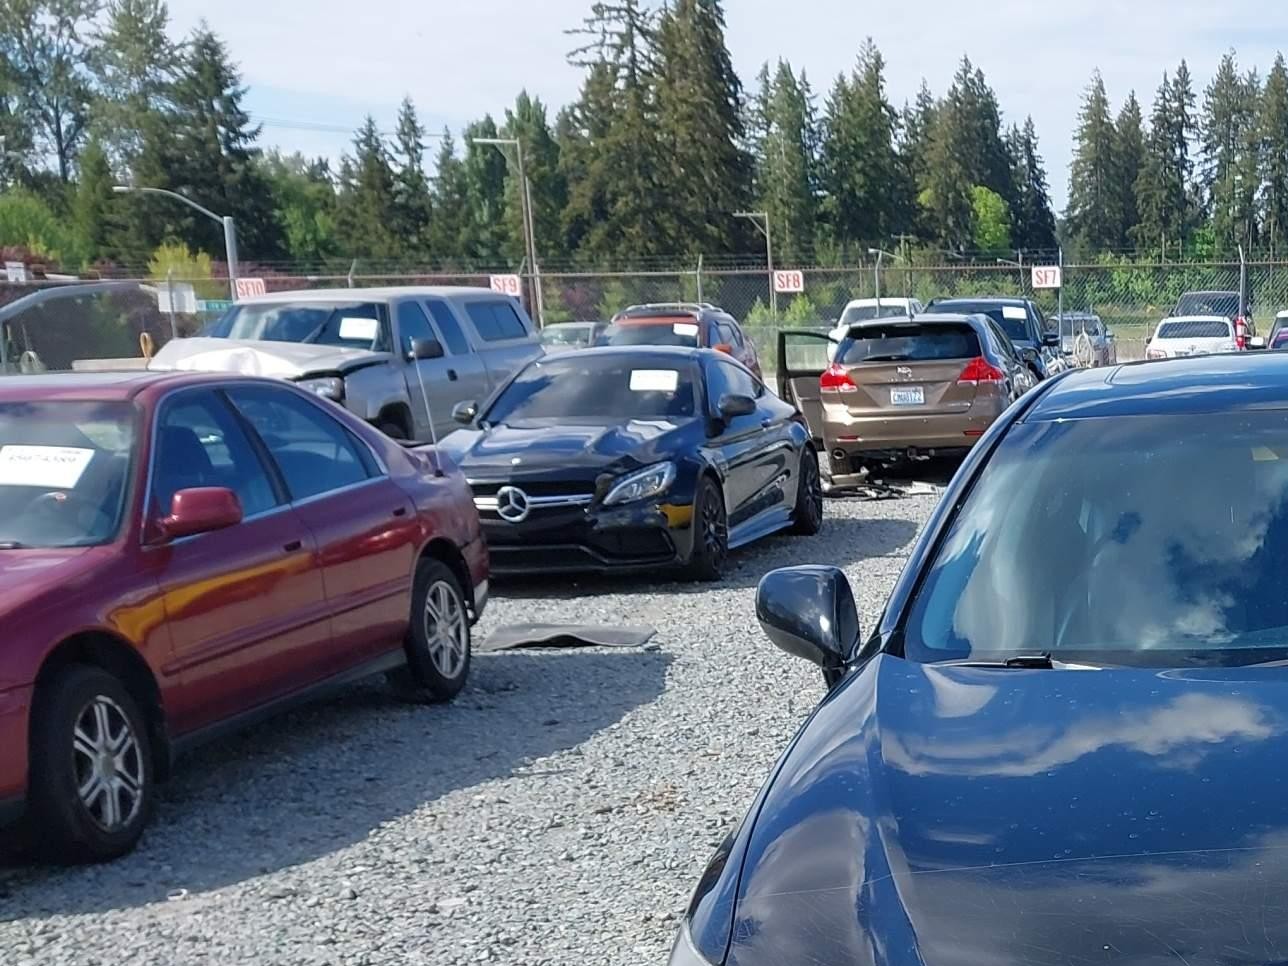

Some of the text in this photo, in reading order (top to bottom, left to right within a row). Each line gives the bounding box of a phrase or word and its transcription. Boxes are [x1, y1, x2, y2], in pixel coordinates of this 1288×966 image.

[494, 277, 517, 293] SF9
[777, 273, 800, 289] SF8
[1036, 270, 1056, 285] SF7
[237, 281, 264, 296] SF10
